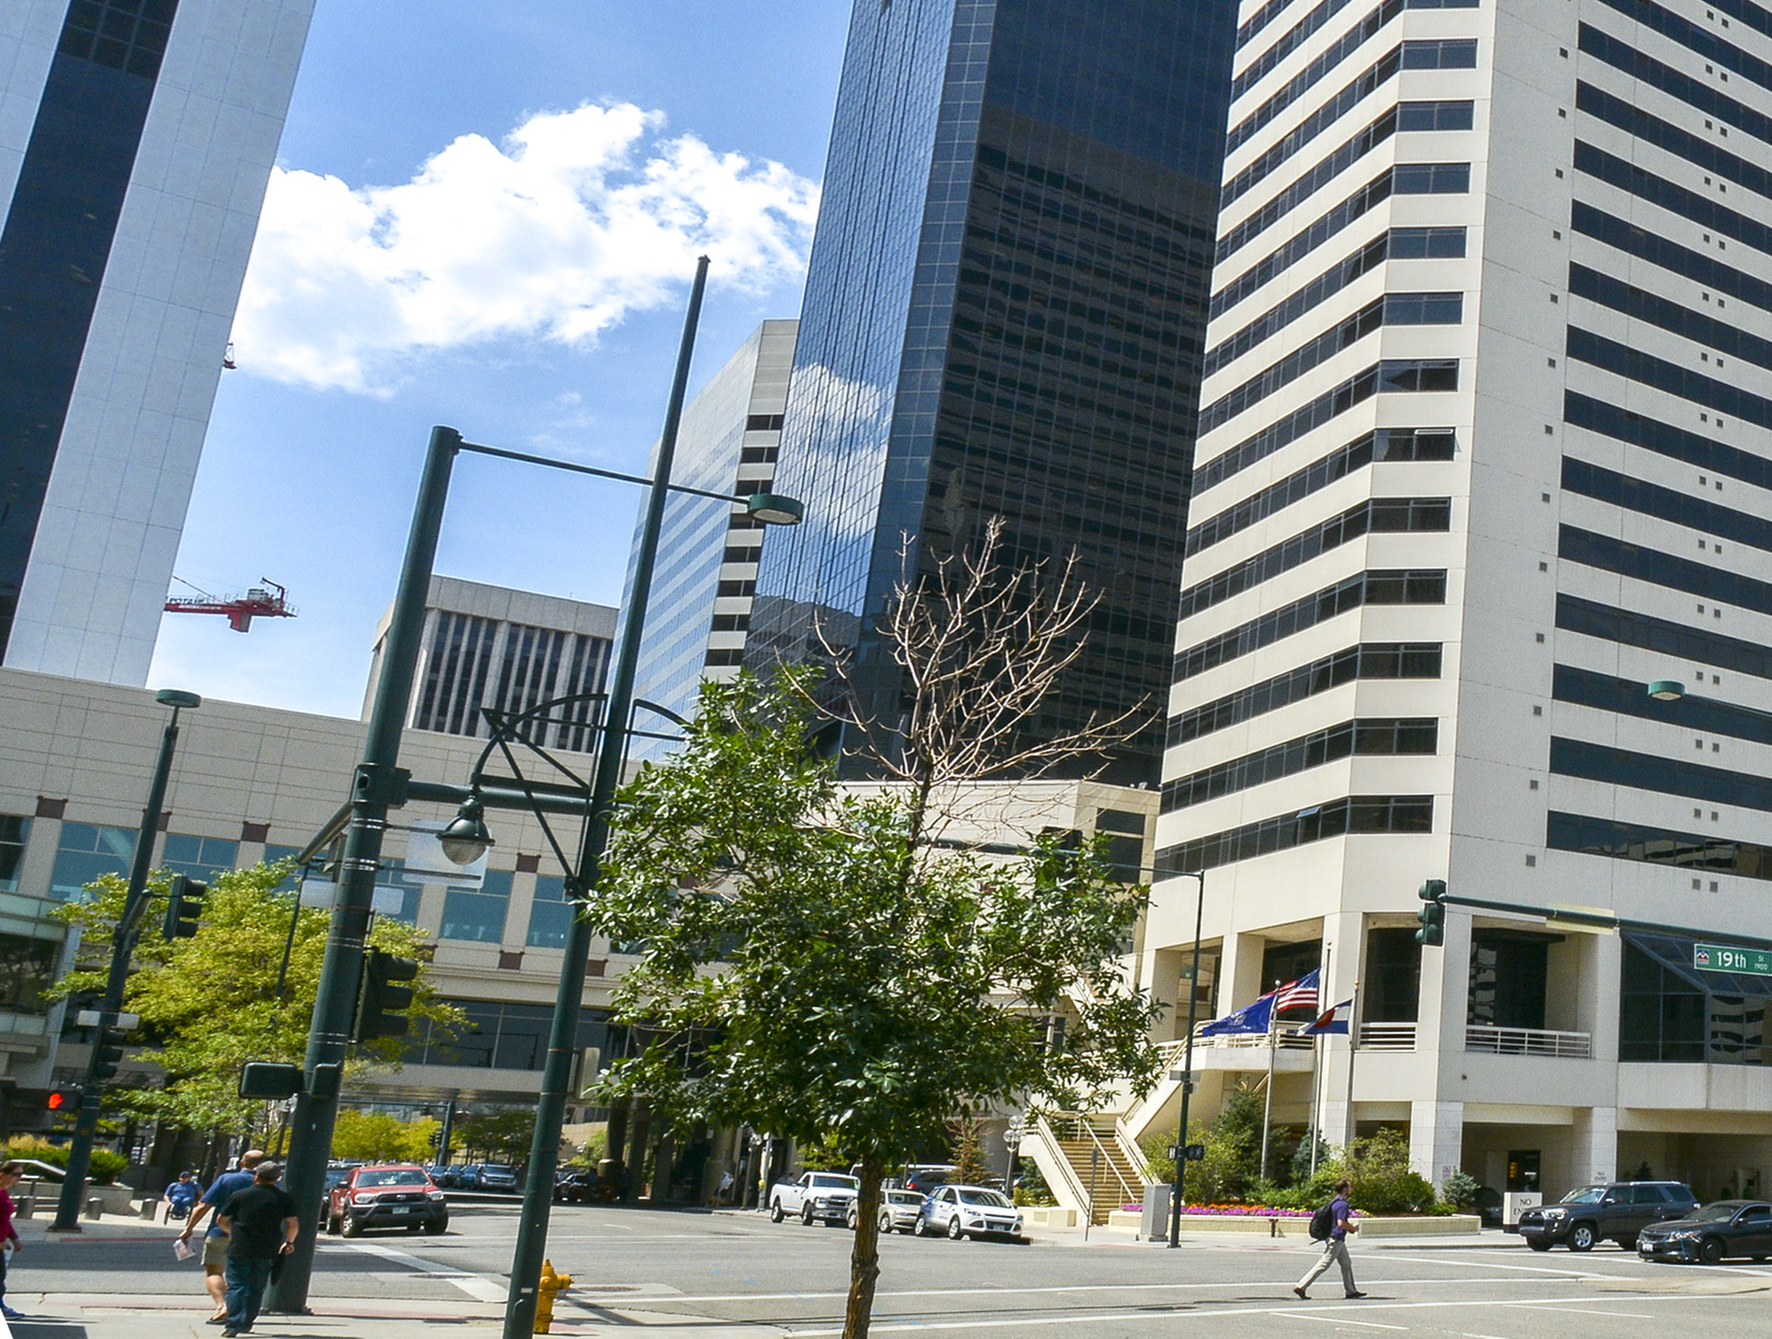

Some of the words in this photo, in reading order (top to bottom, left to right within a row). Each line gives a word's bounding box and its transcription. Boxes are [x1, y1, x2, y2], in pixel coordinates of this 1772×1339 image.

[1717, 951, 1747, 969] 19th
[1754, 963, 1768, 971] 1900
[1520, 1198, 1532, 1206] NO
